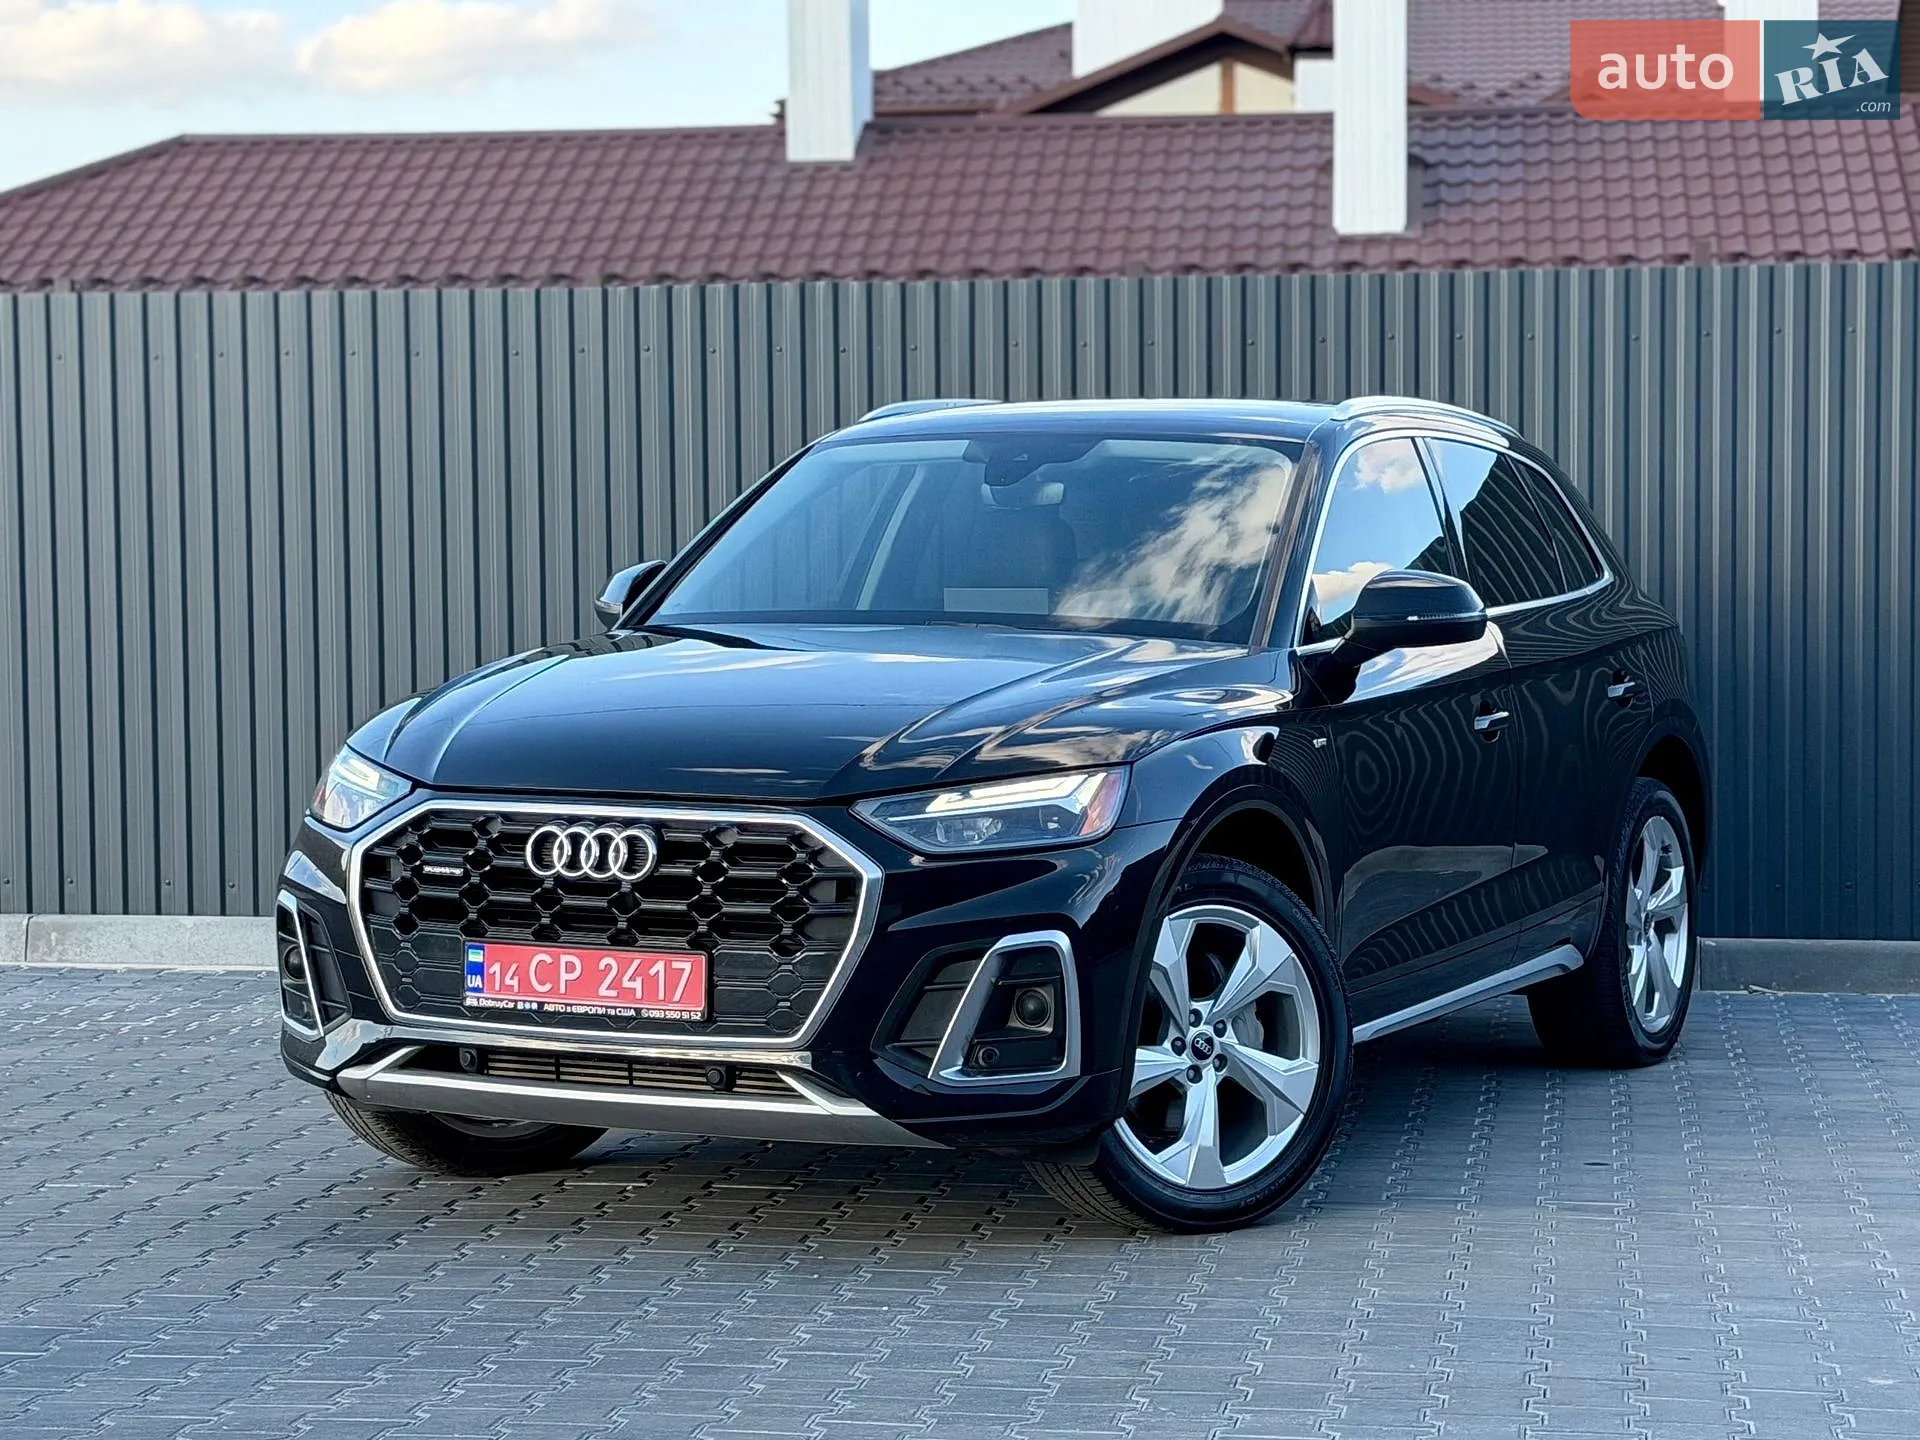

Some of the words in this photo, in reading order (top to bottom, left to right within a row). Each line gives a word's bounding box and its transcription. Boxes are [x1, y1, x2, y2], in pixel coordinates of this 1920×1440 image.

[467, 975, 483, 989] UA
[489, 962, 520, 993] 14
[529, 952, 583, 995] CP
[598, 956, 693, 1002] 2417
